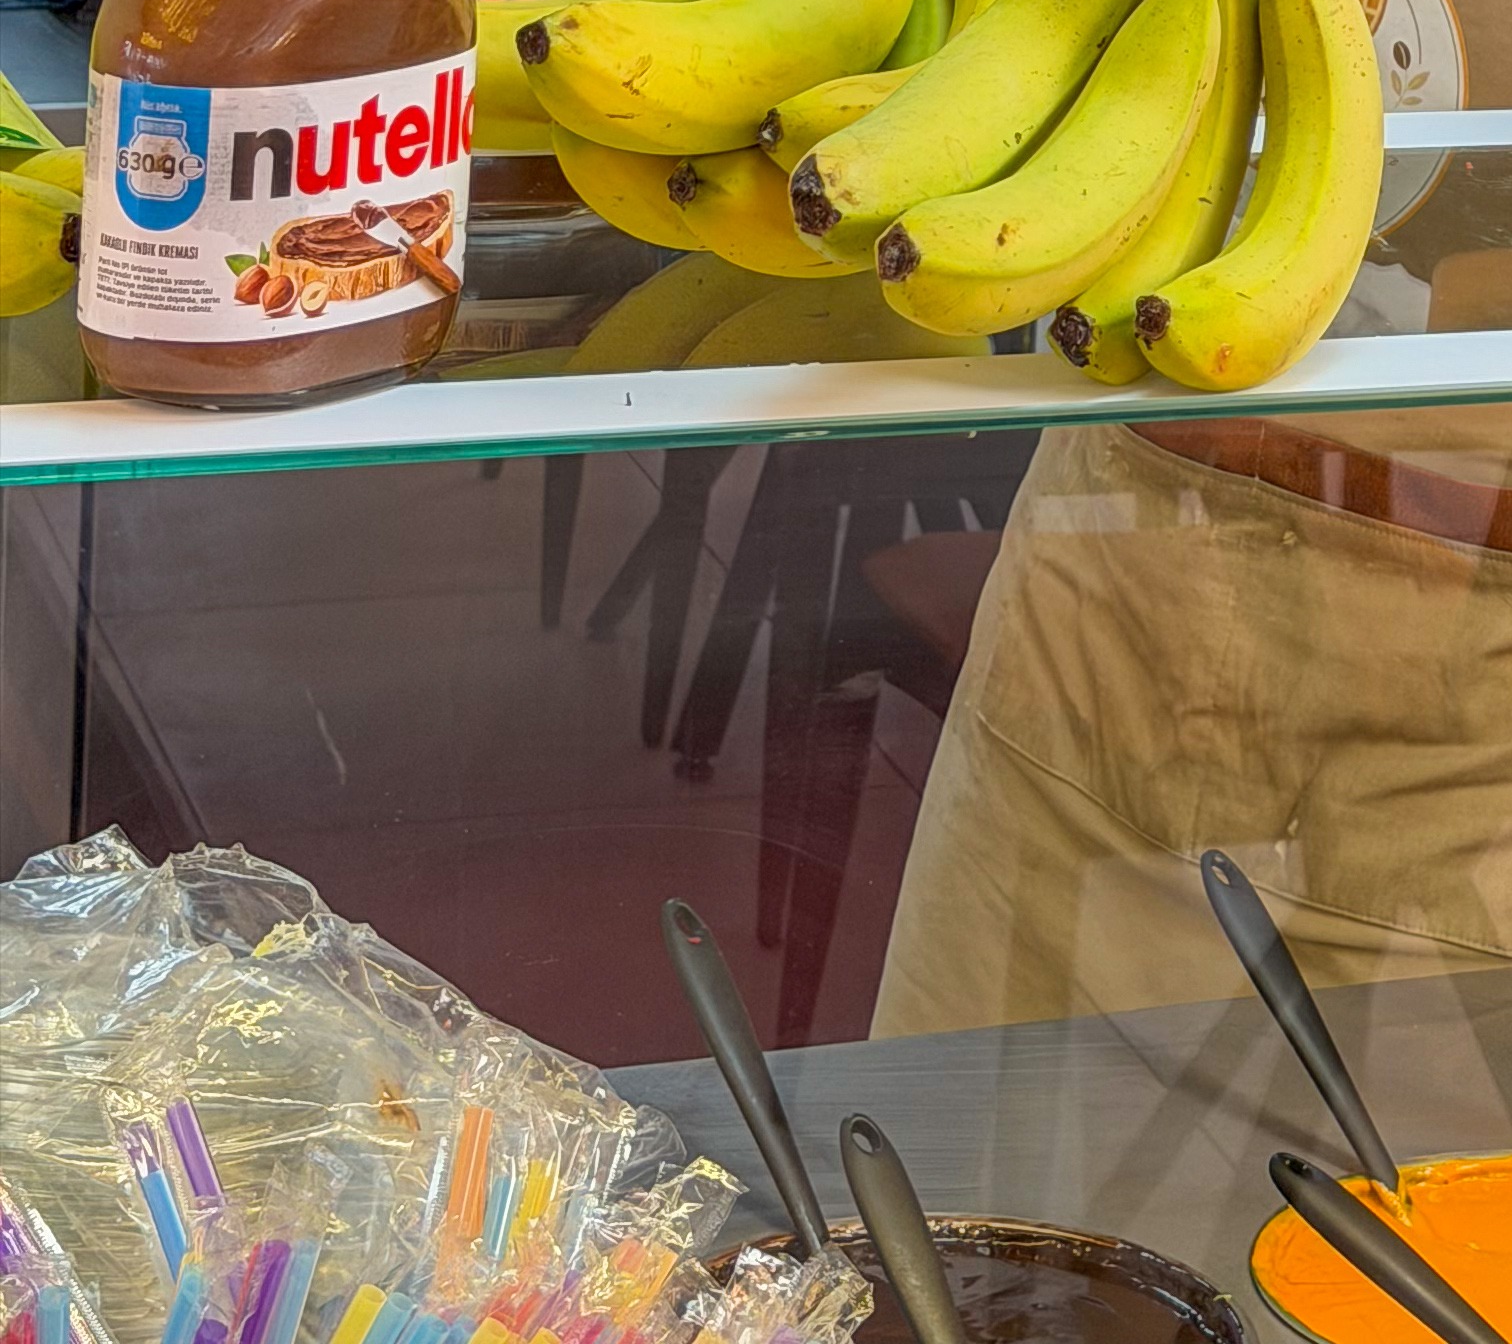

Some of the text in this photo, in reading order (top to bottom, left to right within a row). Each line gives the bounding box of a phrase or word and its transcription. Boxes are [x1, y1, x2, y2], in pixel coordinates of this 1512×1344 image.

[119, 149, 155, 173] 630
[129, 239, 157, 257] FINDIK
[158, 243, 199, 260] KREMASI
